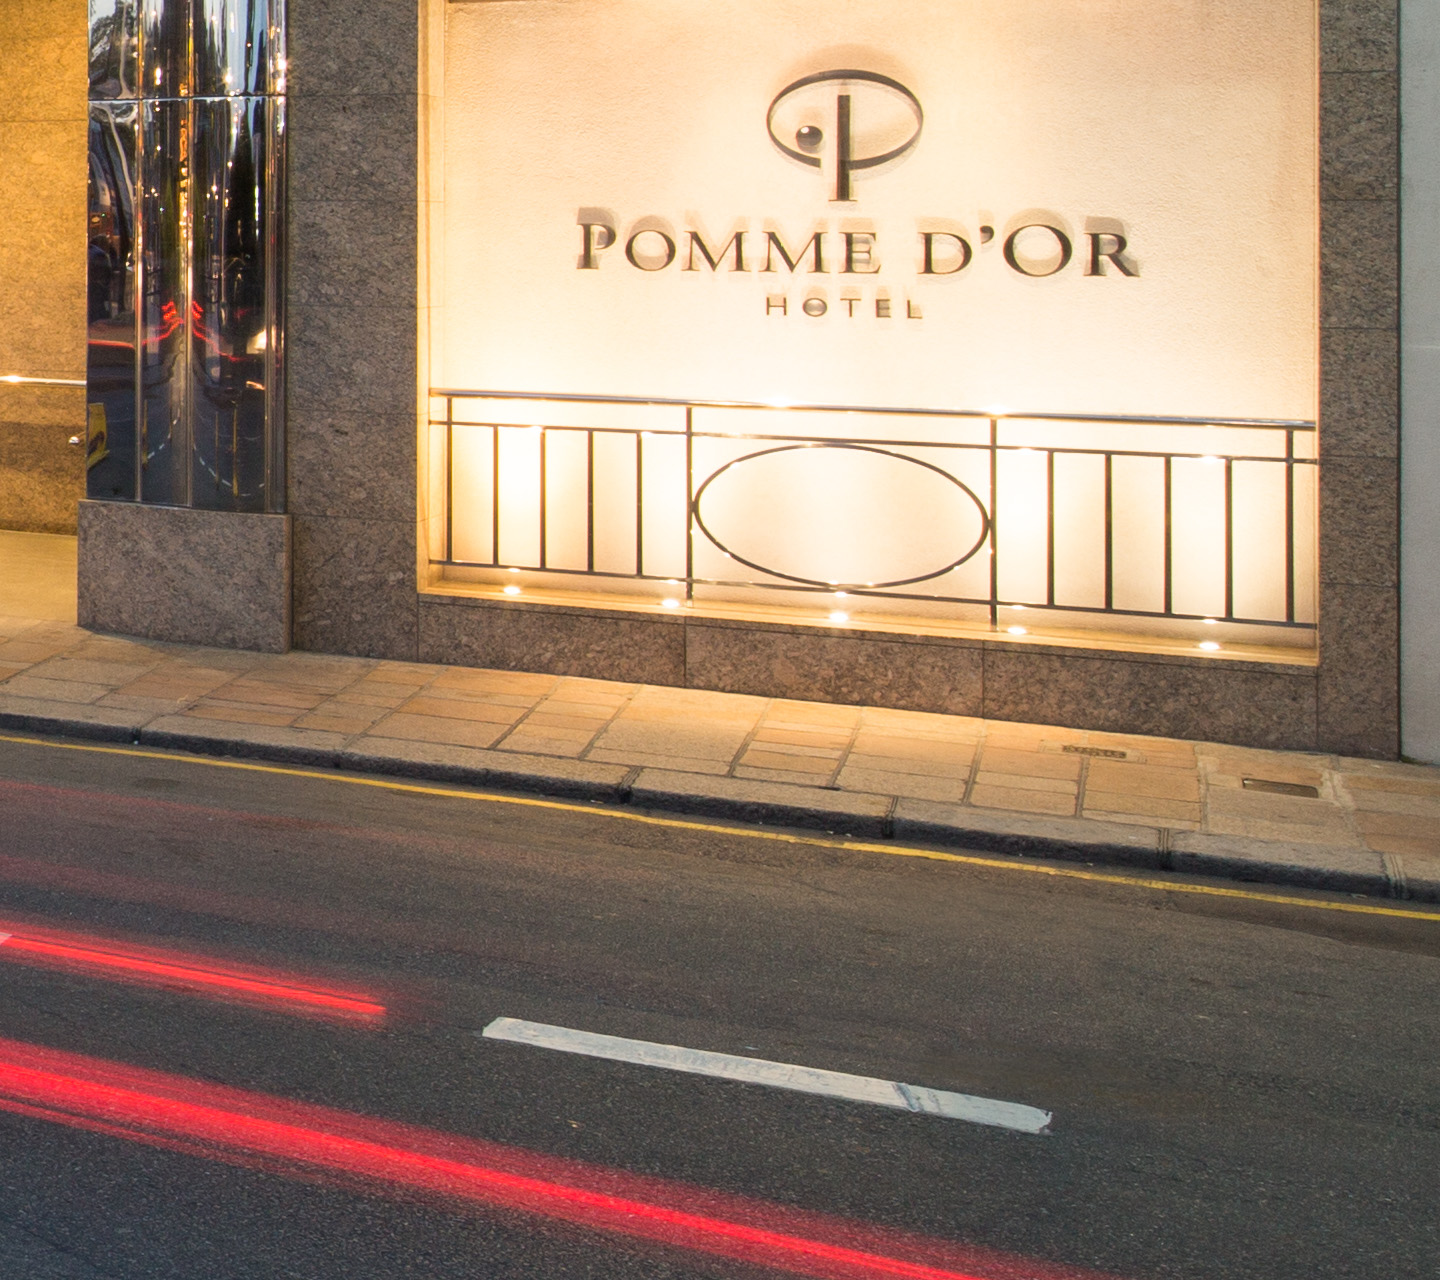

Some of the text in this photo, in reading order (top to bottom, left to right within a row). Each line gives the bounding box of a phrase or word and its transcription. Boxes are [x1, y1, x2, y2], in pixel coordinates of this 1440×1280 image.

[576, 221, 1141, 278] POMME D'OR
[766, 296, 923, 319] HOTEL
